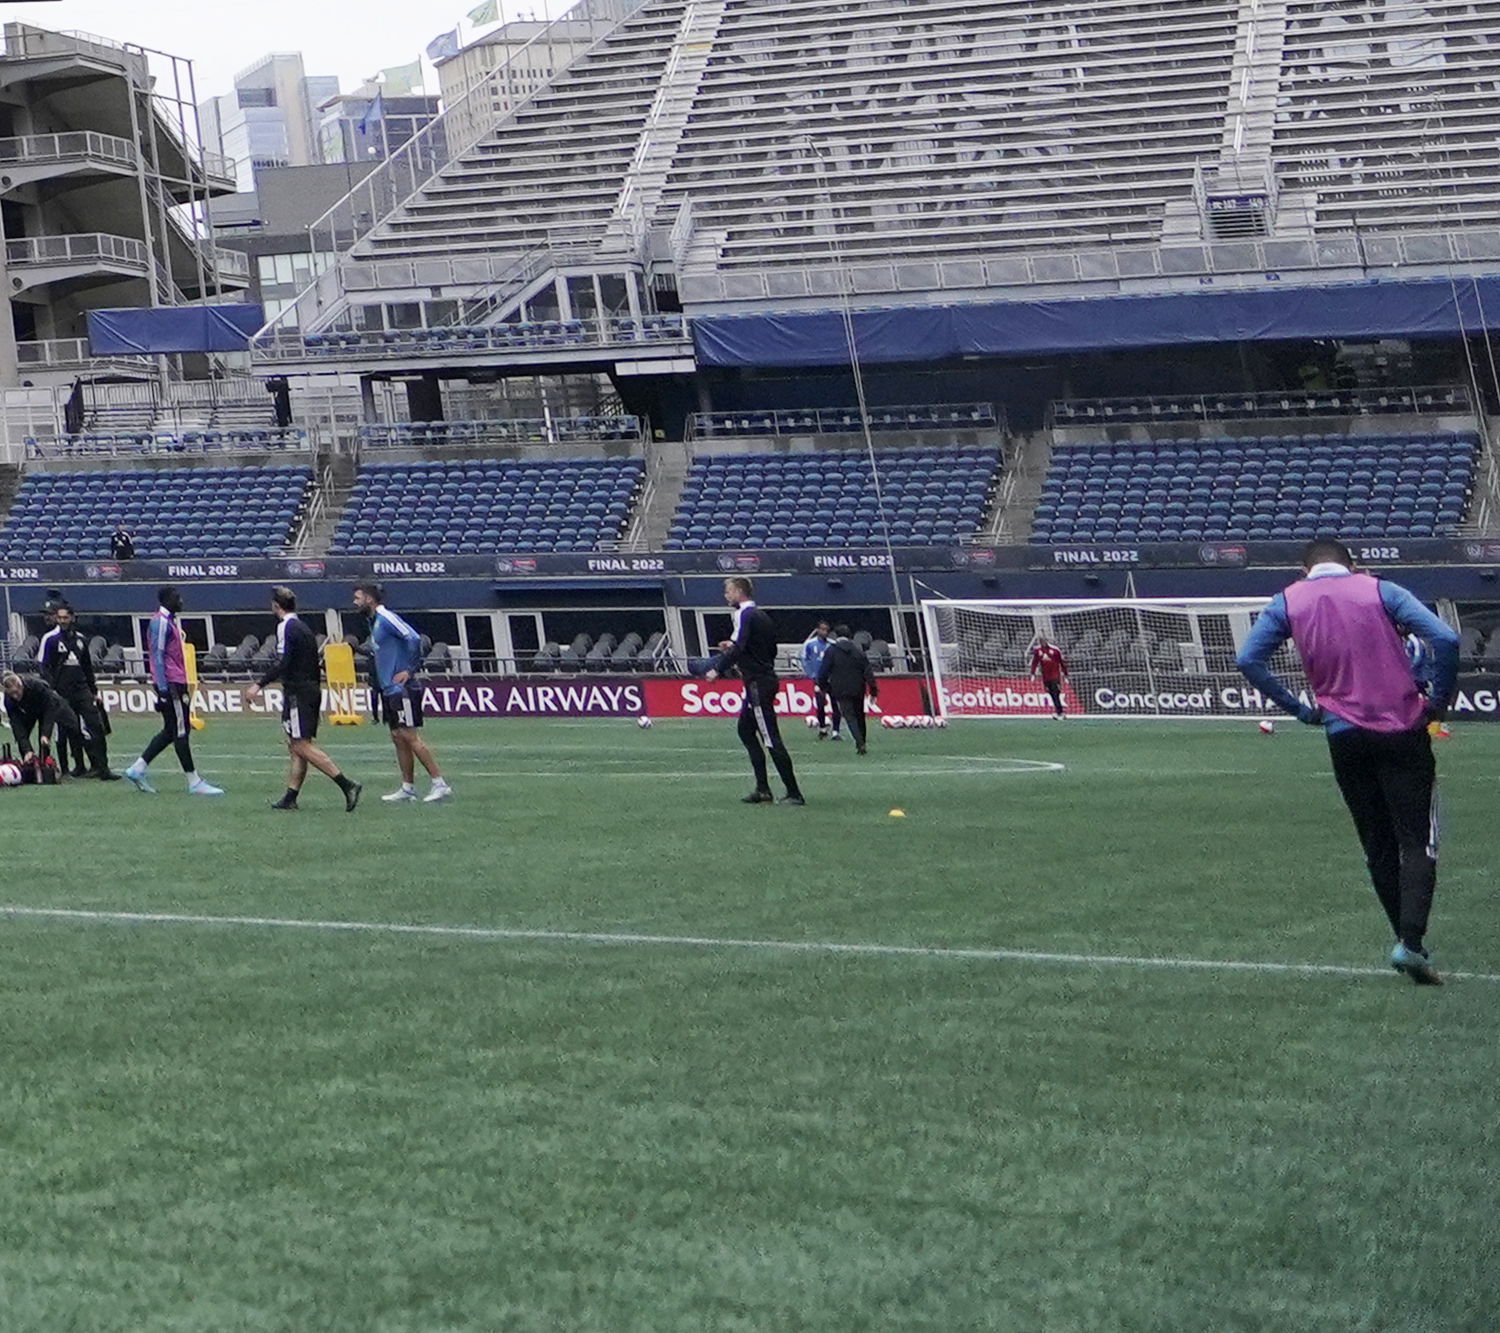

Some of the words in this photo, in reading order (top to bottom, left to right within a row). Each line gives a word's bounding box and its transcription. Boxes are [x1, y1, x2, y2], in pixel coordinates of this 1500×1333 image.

[1053, 551, 1096, 563] FINAL
[1098, 550, 1140, 562] 2022
[1359, 547, 1400, 559] 2022
[587, 559, 628, 571] FINAL
[630, 558, 665, 570] 2022
[813, 555, 854, 567] FINAL
[857, 554, 894, 566] 2022
[10, 568, 39, 579] 2022
[167, 565, 205, 576] FINAL
[207, 564, 238, 576] 2022
[372, 562, 412, 574] FINAL
[414, 561, 446, 573] 2022
[190, 689, 243, 713] ARE
[421, 686, 499, 712] ATAR
[506, 685, 643, 712] AIRWAYS
[1094, 687, 1214, 709] Concacaf
